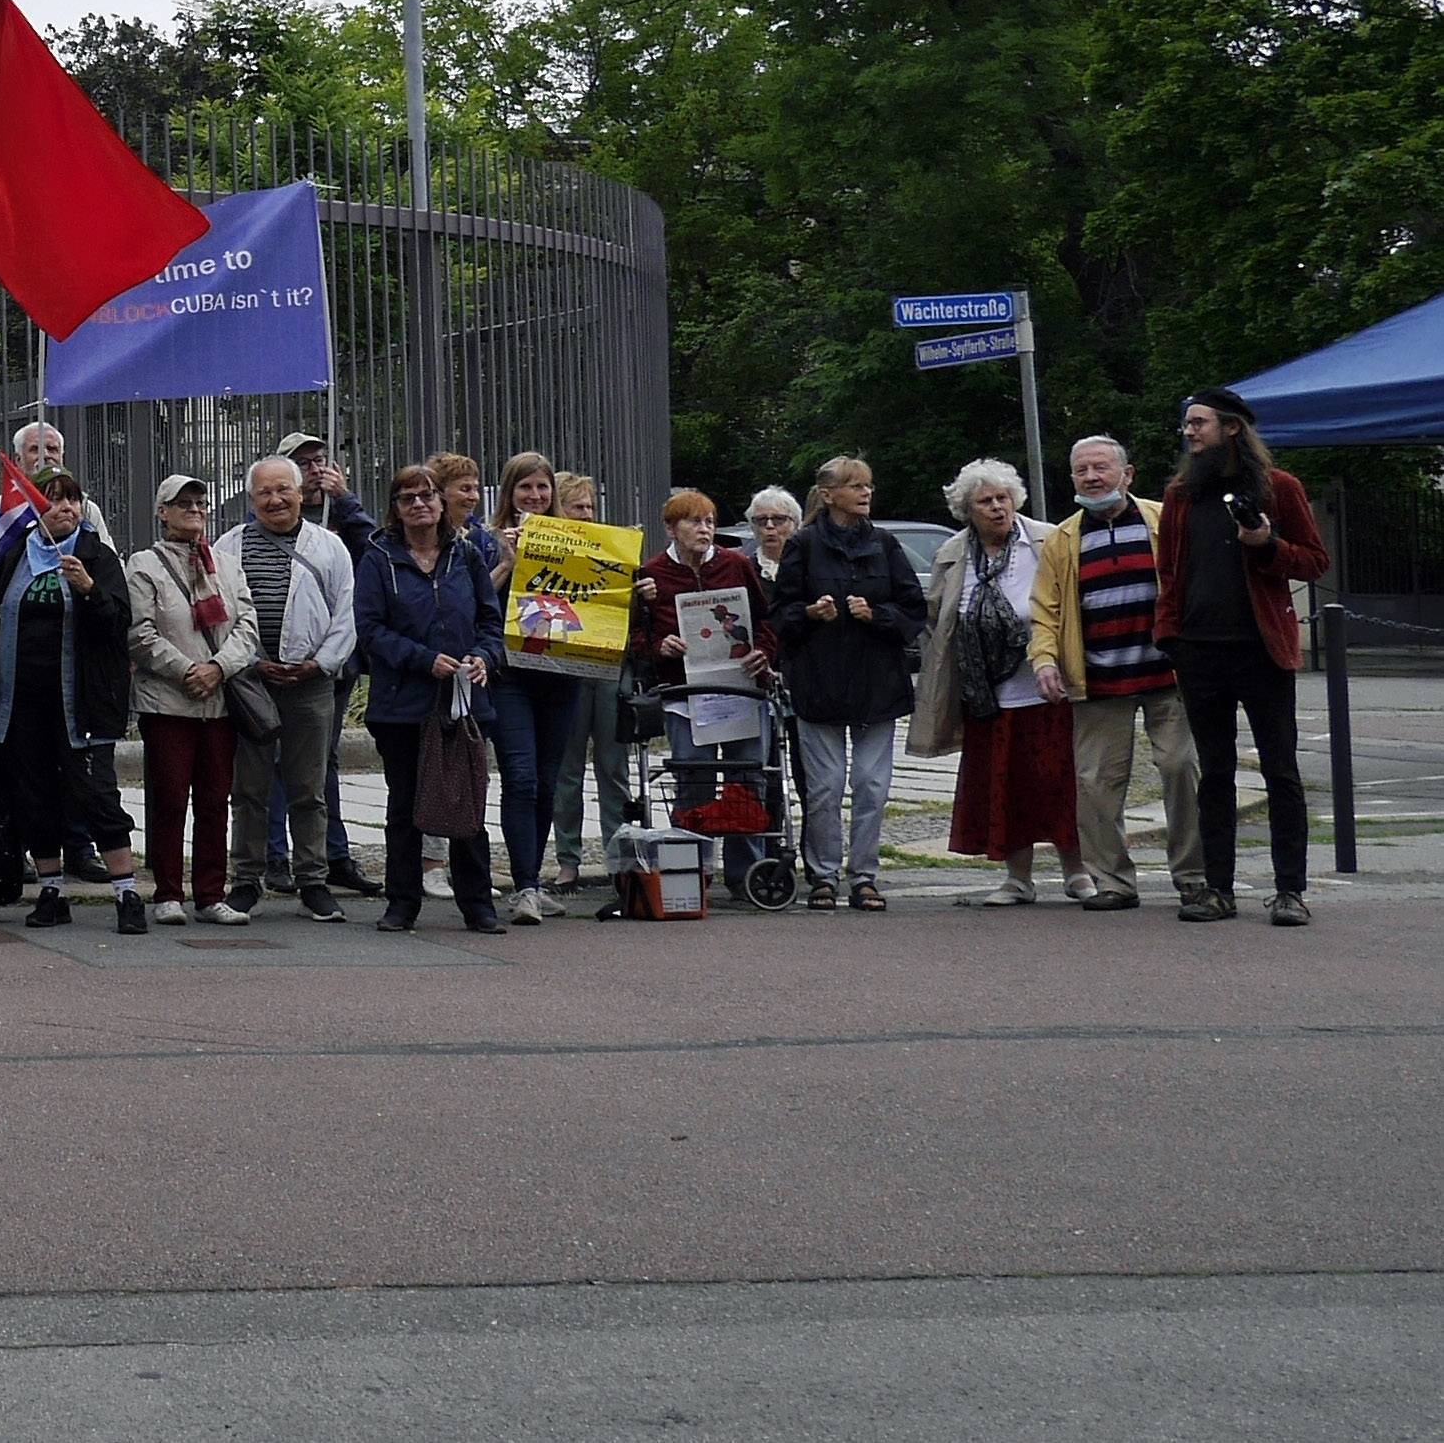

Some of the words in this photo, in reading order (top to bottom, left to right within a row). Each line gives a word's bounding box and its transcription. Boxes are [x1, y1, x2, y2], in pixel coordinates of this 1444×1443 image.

[223, 250, 252, 270] to
[287, 287, 313, 306] it?
[901, 299, 1007, 320] Wächterstraße
[527, 531, 601, 551] Wirtschaftskrieg
